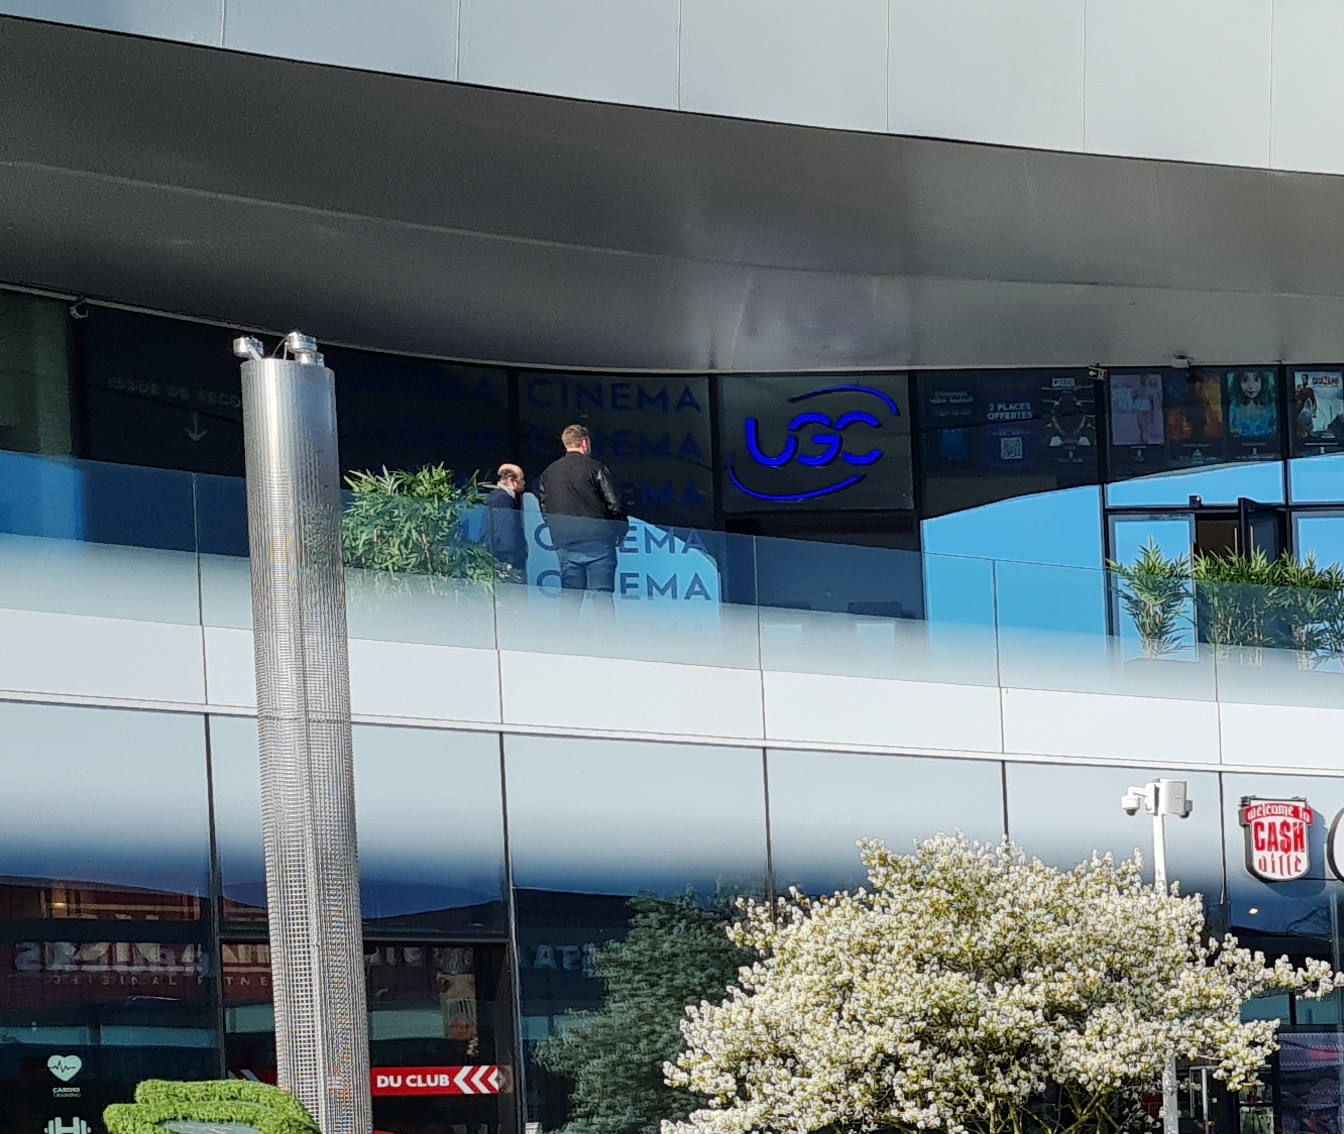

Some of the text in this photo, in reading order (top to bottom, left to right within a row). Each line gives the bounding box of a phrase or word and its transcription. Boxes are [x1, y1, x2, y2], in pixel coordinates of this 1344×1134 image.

[526, 377, 701, 413] CINEMA
[998, 402, 1031, 411] PLACES
[987, 410, 1033, 421] OFFERTES
[744, 410, 882, 467] UGC
[1247, 803, 1294, 820] welcome
[376, 1073, 450, 1088] DU CLUB
